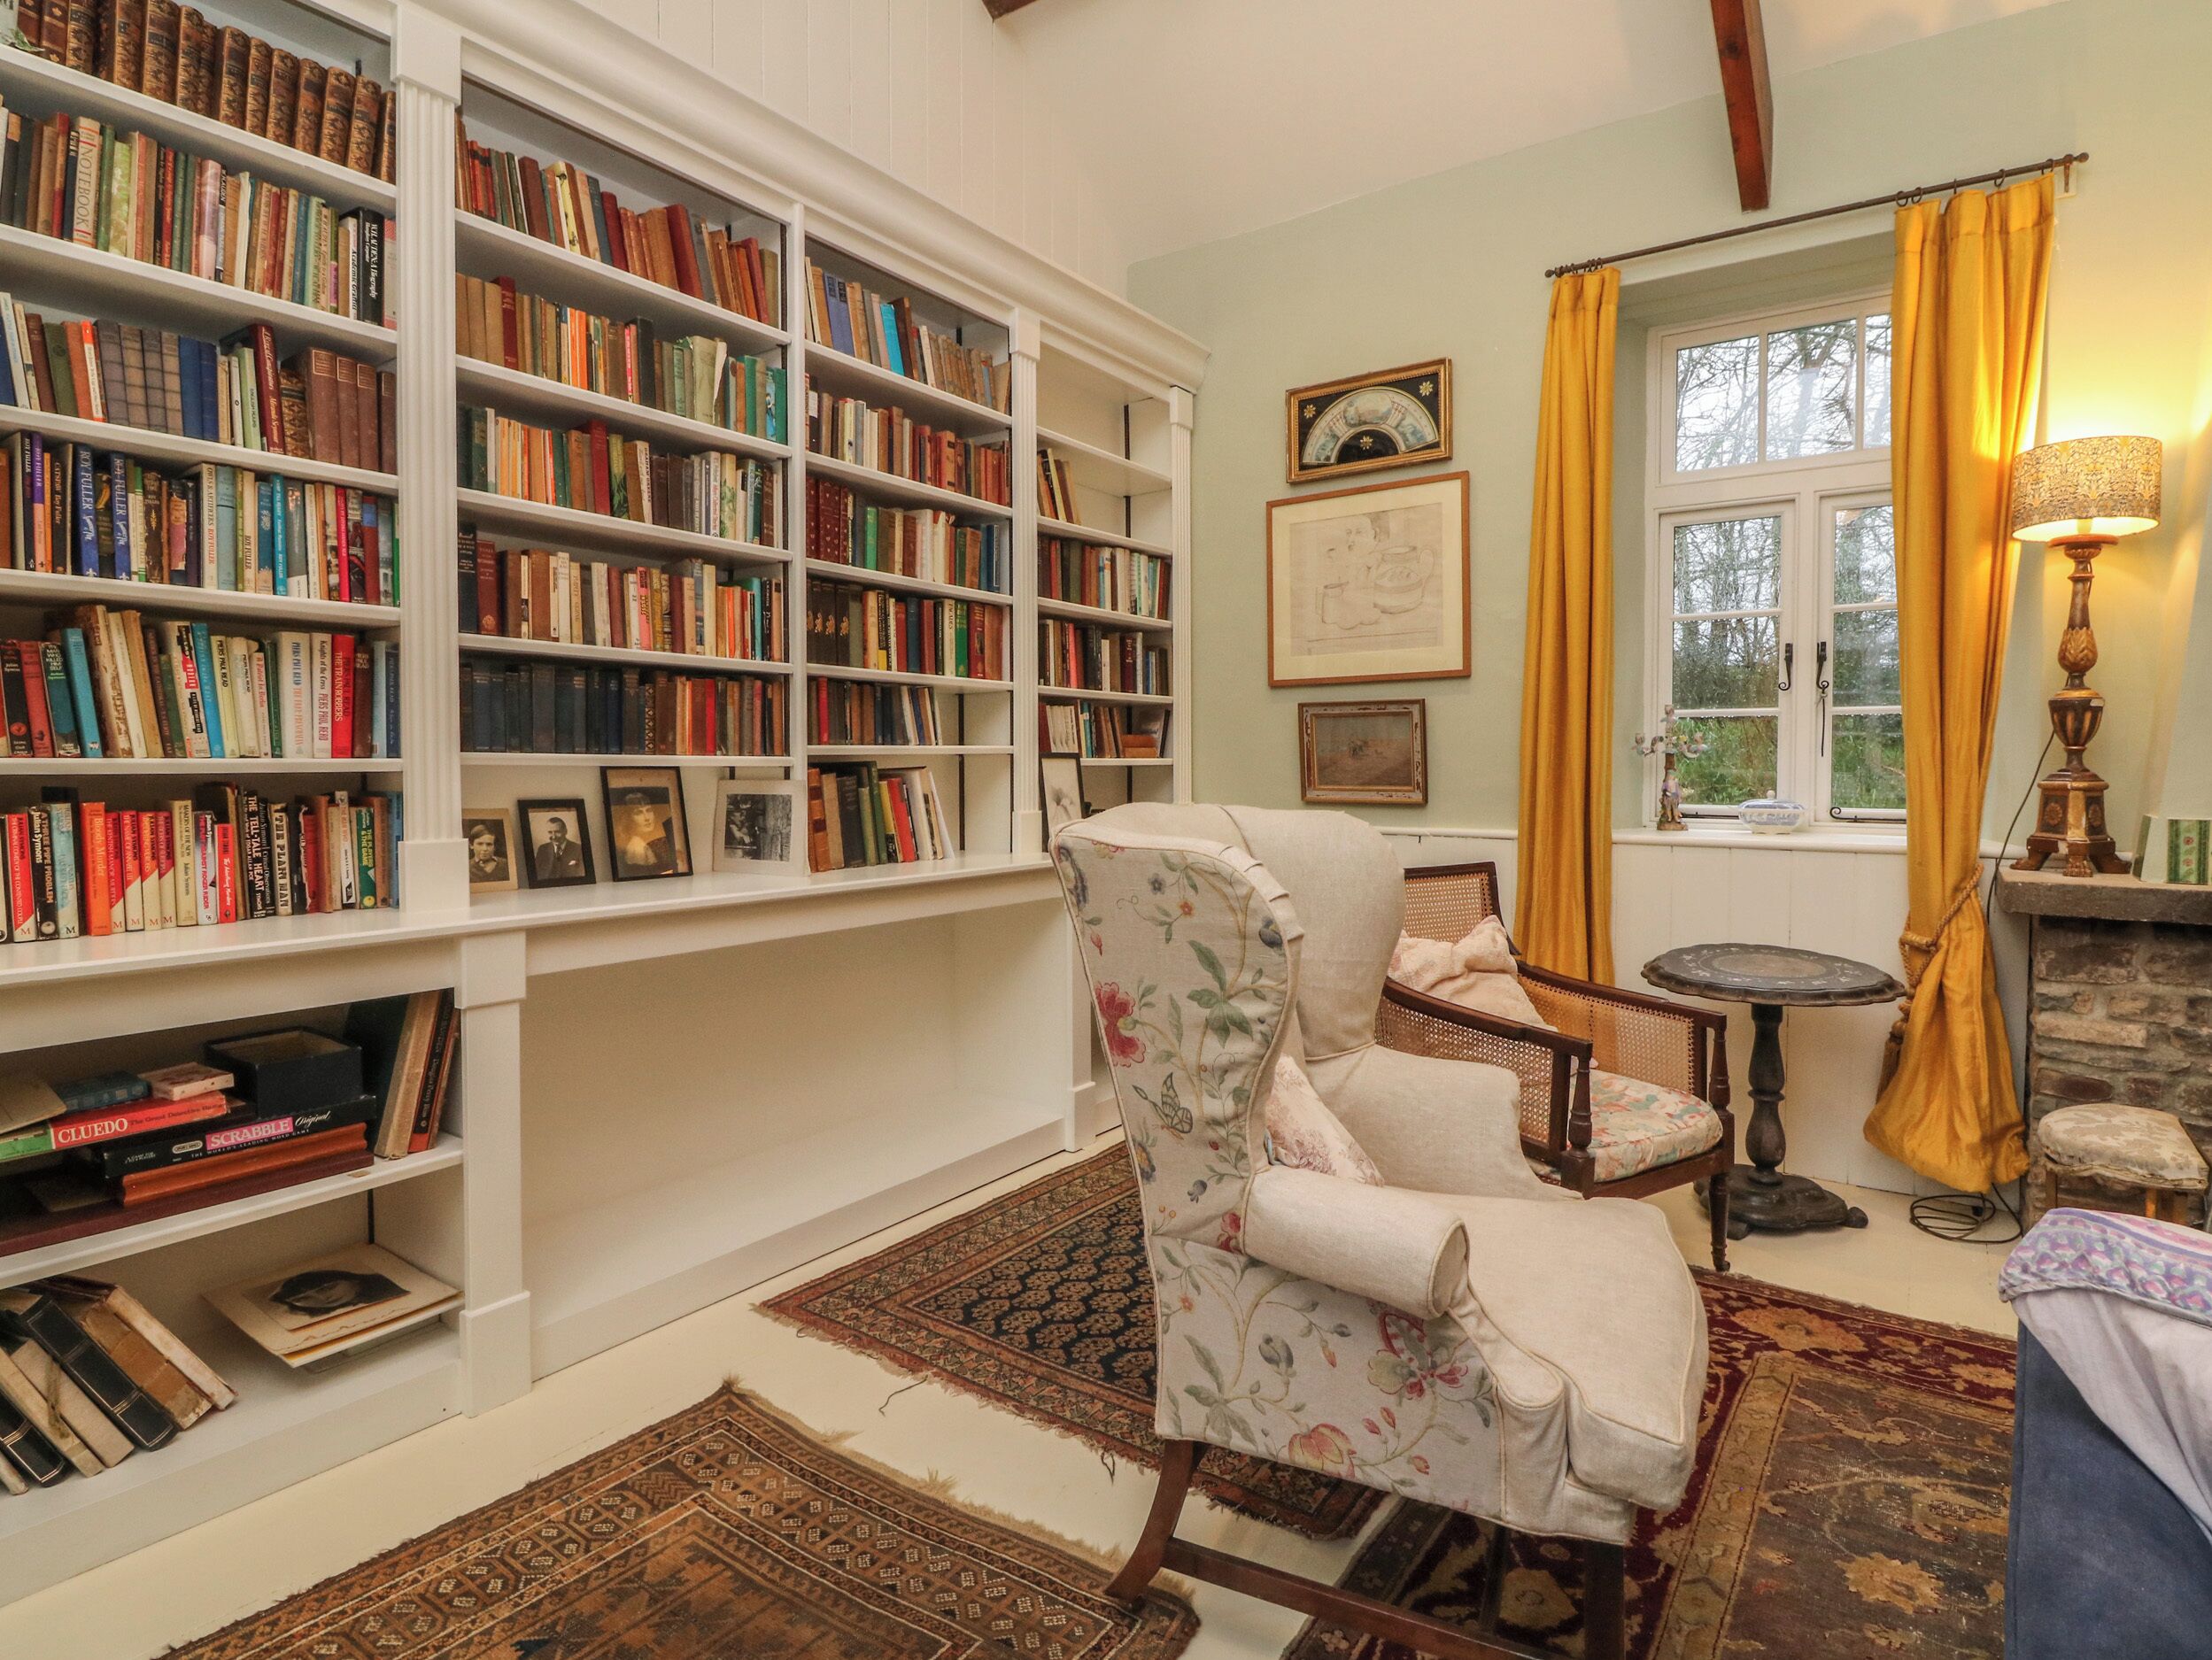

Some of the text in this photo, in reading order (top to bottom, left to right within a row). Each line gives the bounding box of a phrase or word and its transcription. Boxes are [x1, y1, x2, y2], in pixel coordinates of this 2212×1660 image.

[76, 146, 93, 228] NOTEBOOK
[368, 269, 379, 299] Biography
[269, 420, 279, 444] Seymour
[81, 451, 93, 509] ROY FULLER
[114, 458, 127, 515] ROY FULLER
[53, 493, 62, 504] Roy
[217, 640, 226, 656] PIERS
[292, 642, 302, 657] PIERS
[319, 640, 328, 660] Knights
[293, 658, 302, 670] PAUL
[292, 671, 302, 686] READ
[294, 687, 304, 698] THE
[318, 694, 329, 710] PIERS
[335, 690, 344, 722] ROBBERS
[318, 711, 329, 726] PAUL
[344, 696, 352, 717] READ
[318, 727, 329, 741] READ
[94, 817, 104, 844] Bloody
[205, 815, 213, 831] Julian
[32, 834, 43, 863] Symons
[248, 796, 265, 891] THE TELL-TALE HEART
[97, 846, 105, 877] Murder
[275, 815, 289, 907] THE PLAIN MAN
[421, 1057, 439, 1118] Douglas Bliss
[58, 1117, 128, 1145] CLUEDO
[206, 1146, 236, 1155] WORLD'S
[238, 1139, 269, 1149] LEADING
[296, 1128, 311, 1137] GAME
[211, 1117, 290, 1147] SCRABBLE
[295, 1110, 331, 1129] Original
